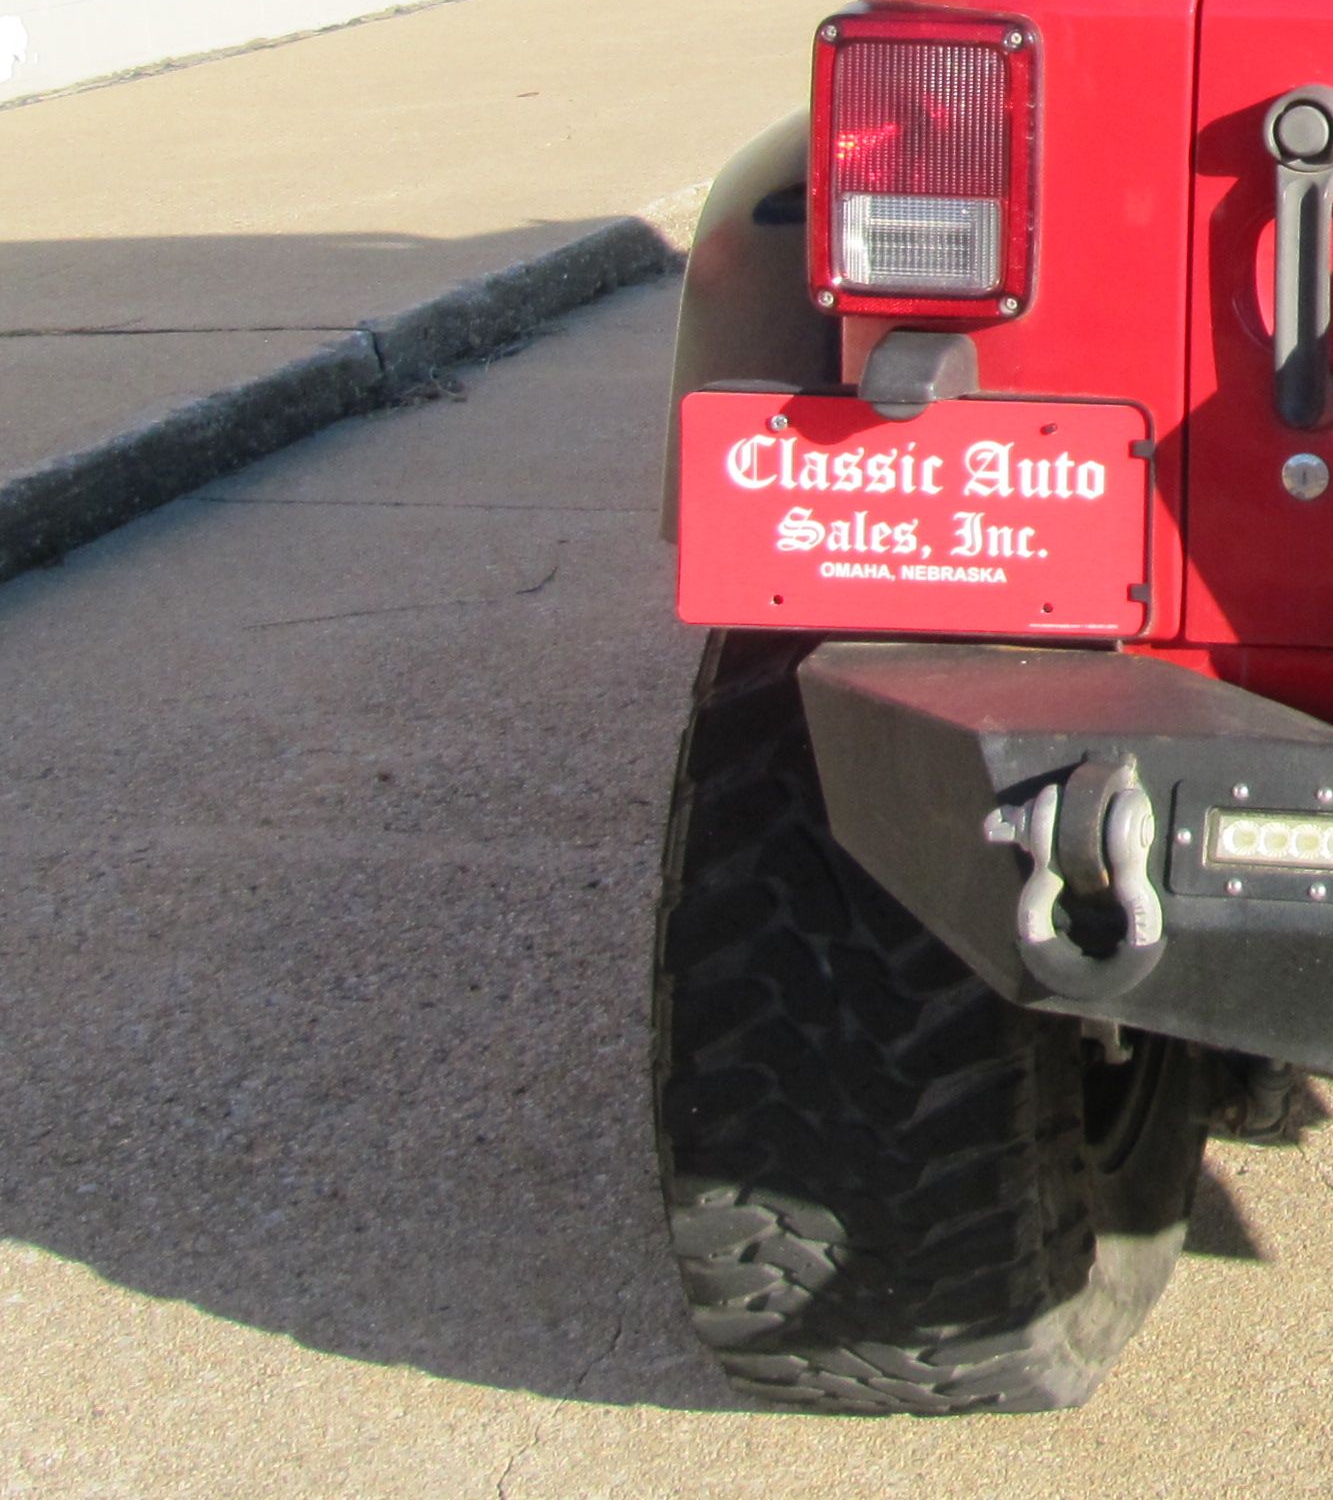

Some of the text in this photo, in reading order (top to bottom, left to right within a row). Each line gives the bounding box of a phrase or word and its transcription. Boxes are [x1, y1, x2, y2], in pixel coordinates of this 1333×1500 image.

[727, 434, 1106, 499] Classic Auto
[776, 507, 1050, 559] Sales, Inc.
[820, 562, 1007, 584] OMAHA, NEBRASKA
